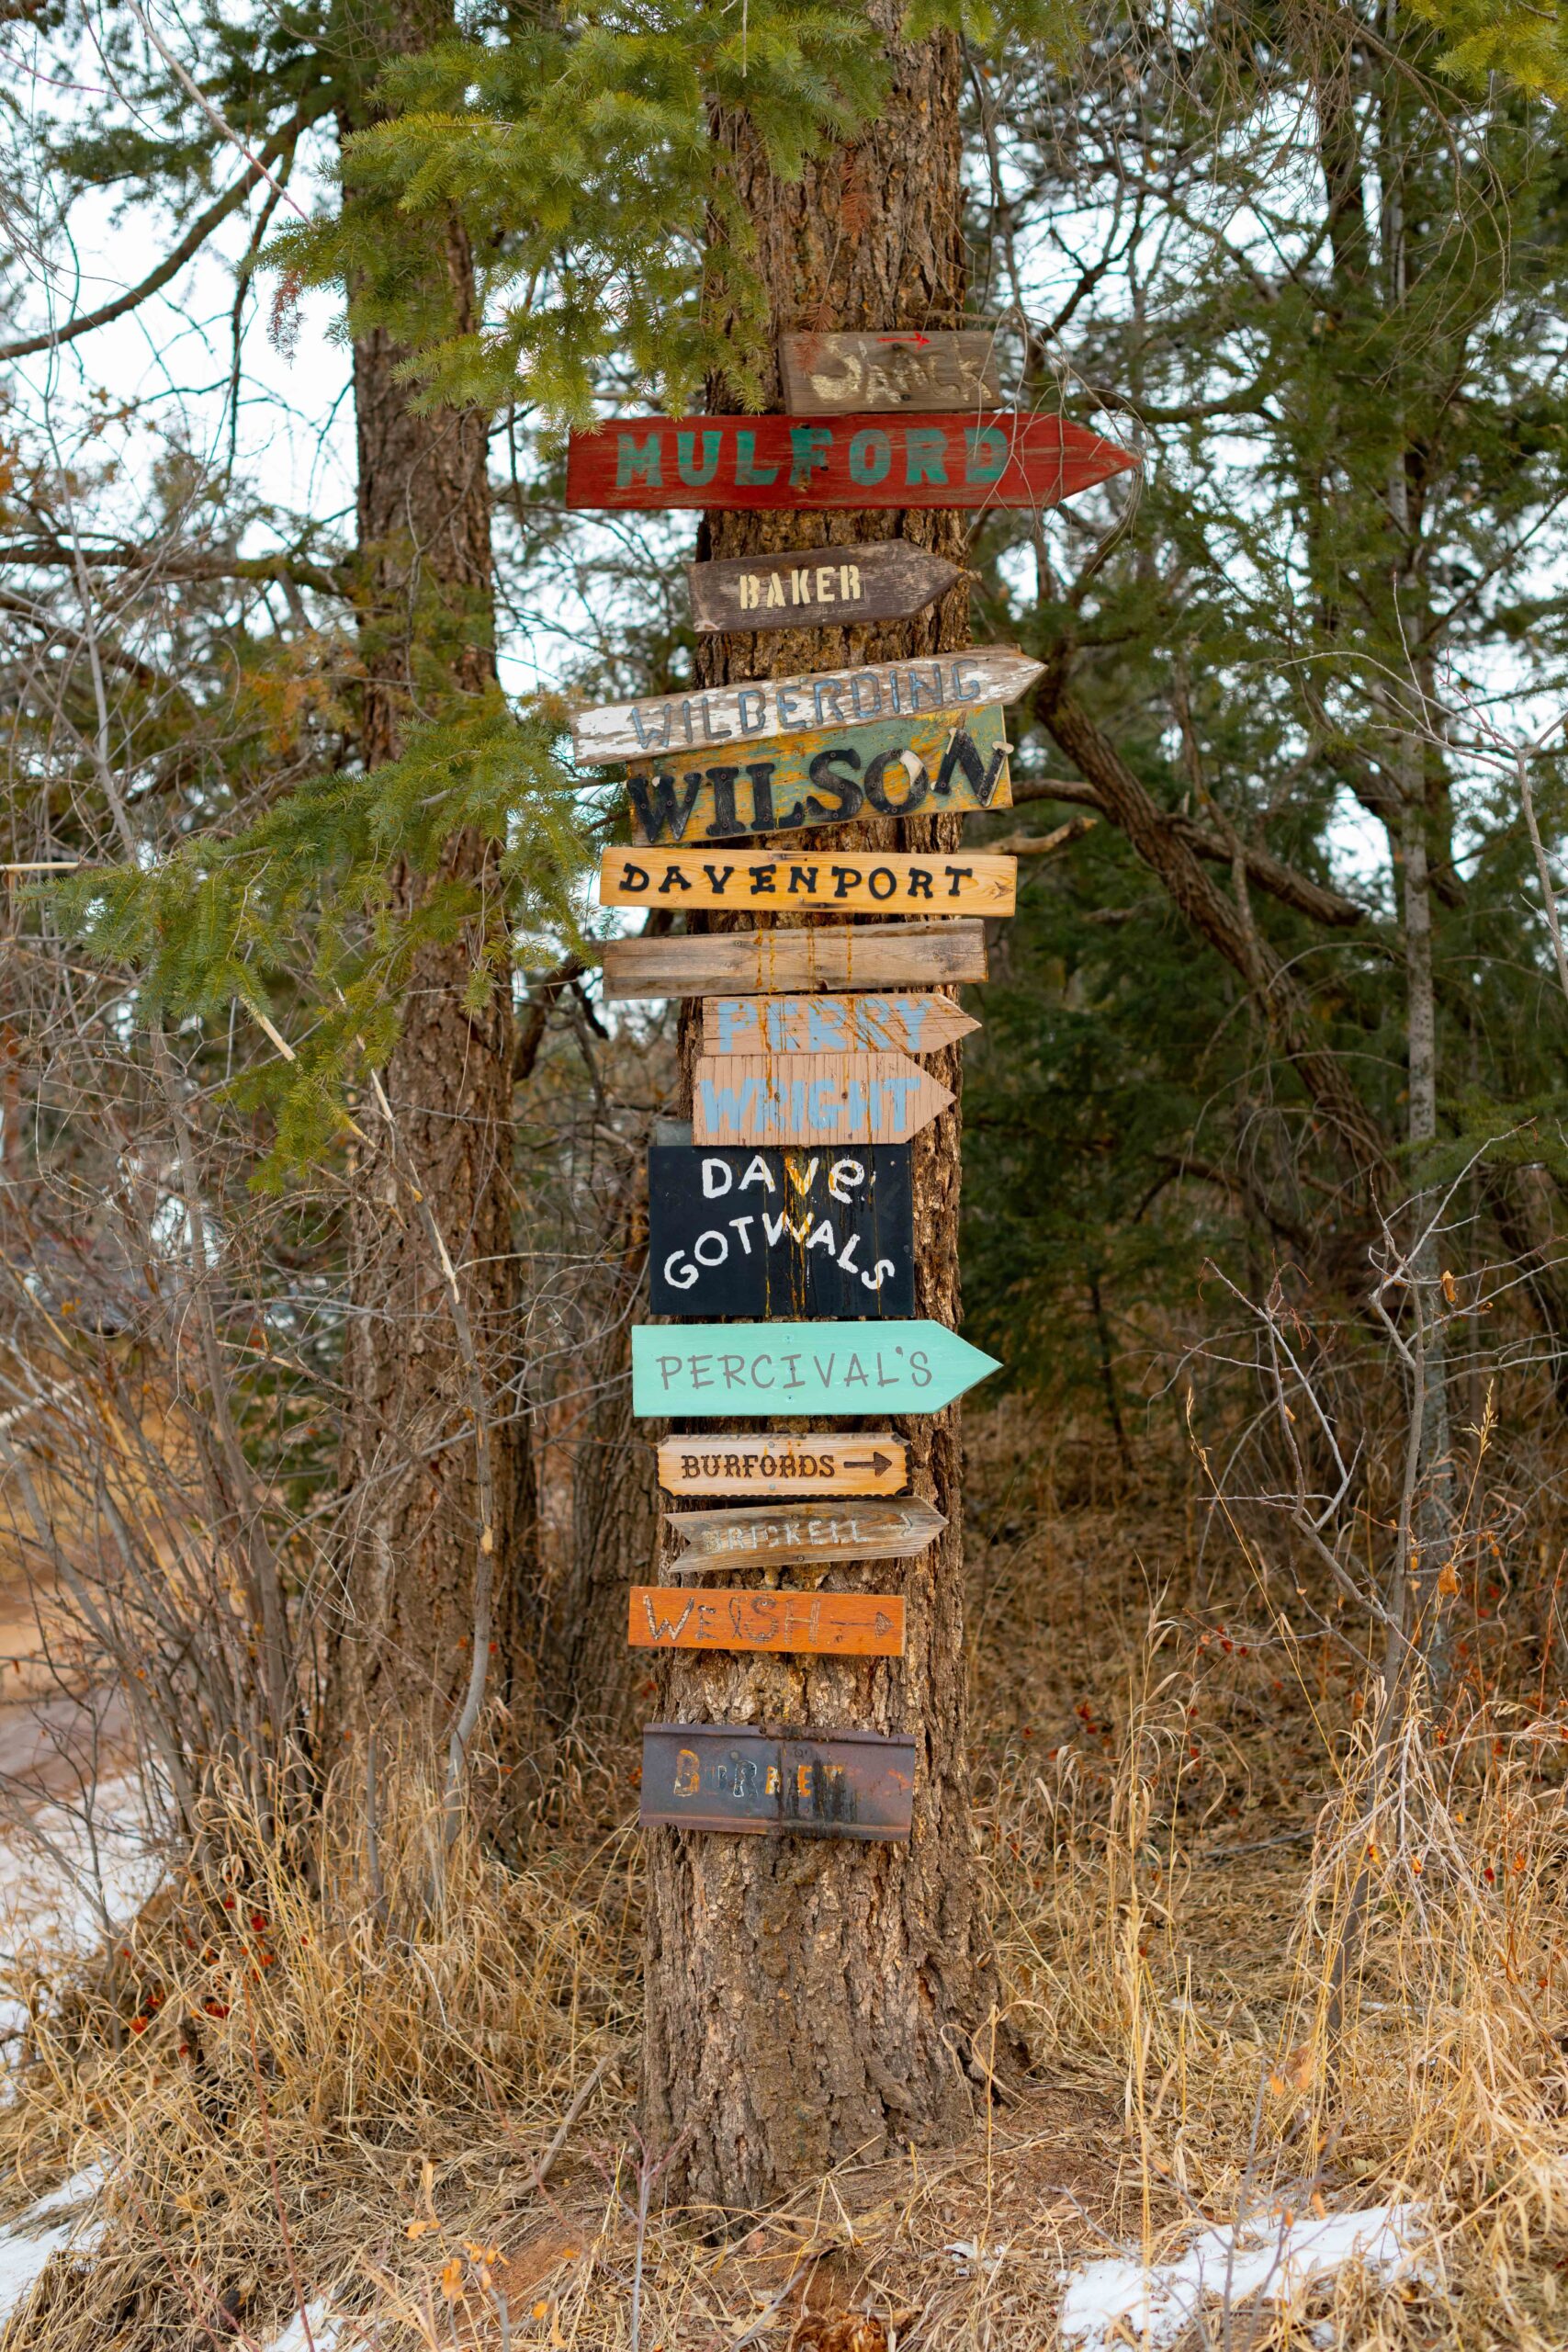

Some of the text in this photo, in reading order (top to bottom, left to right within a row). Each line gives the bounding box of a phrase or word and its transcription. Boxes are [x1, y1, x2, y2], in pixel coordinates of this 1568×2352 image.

[615, 427, 1009, 487] MULFORD
[739, 565, 862, 610] BAKER
[631, 659, 981, 750] WILBERDING
[626, 727, 1013, 843] WILSON
[619, 863, 973, 901] DAVENPORT
[717, 998, 934, 1053] PERRY
[699, 1077, 920, 1134] WRIGHT
[663, 1211, 896, 1290] GOTWALS
[656, 1346, 933, 1391] PERCIVAL'S
[681, 1454, 836, 1480] BURFORDS
[701, 1520, 869, 1554] BRICKELL
[643, 1594, 822, 1646] WELSH
